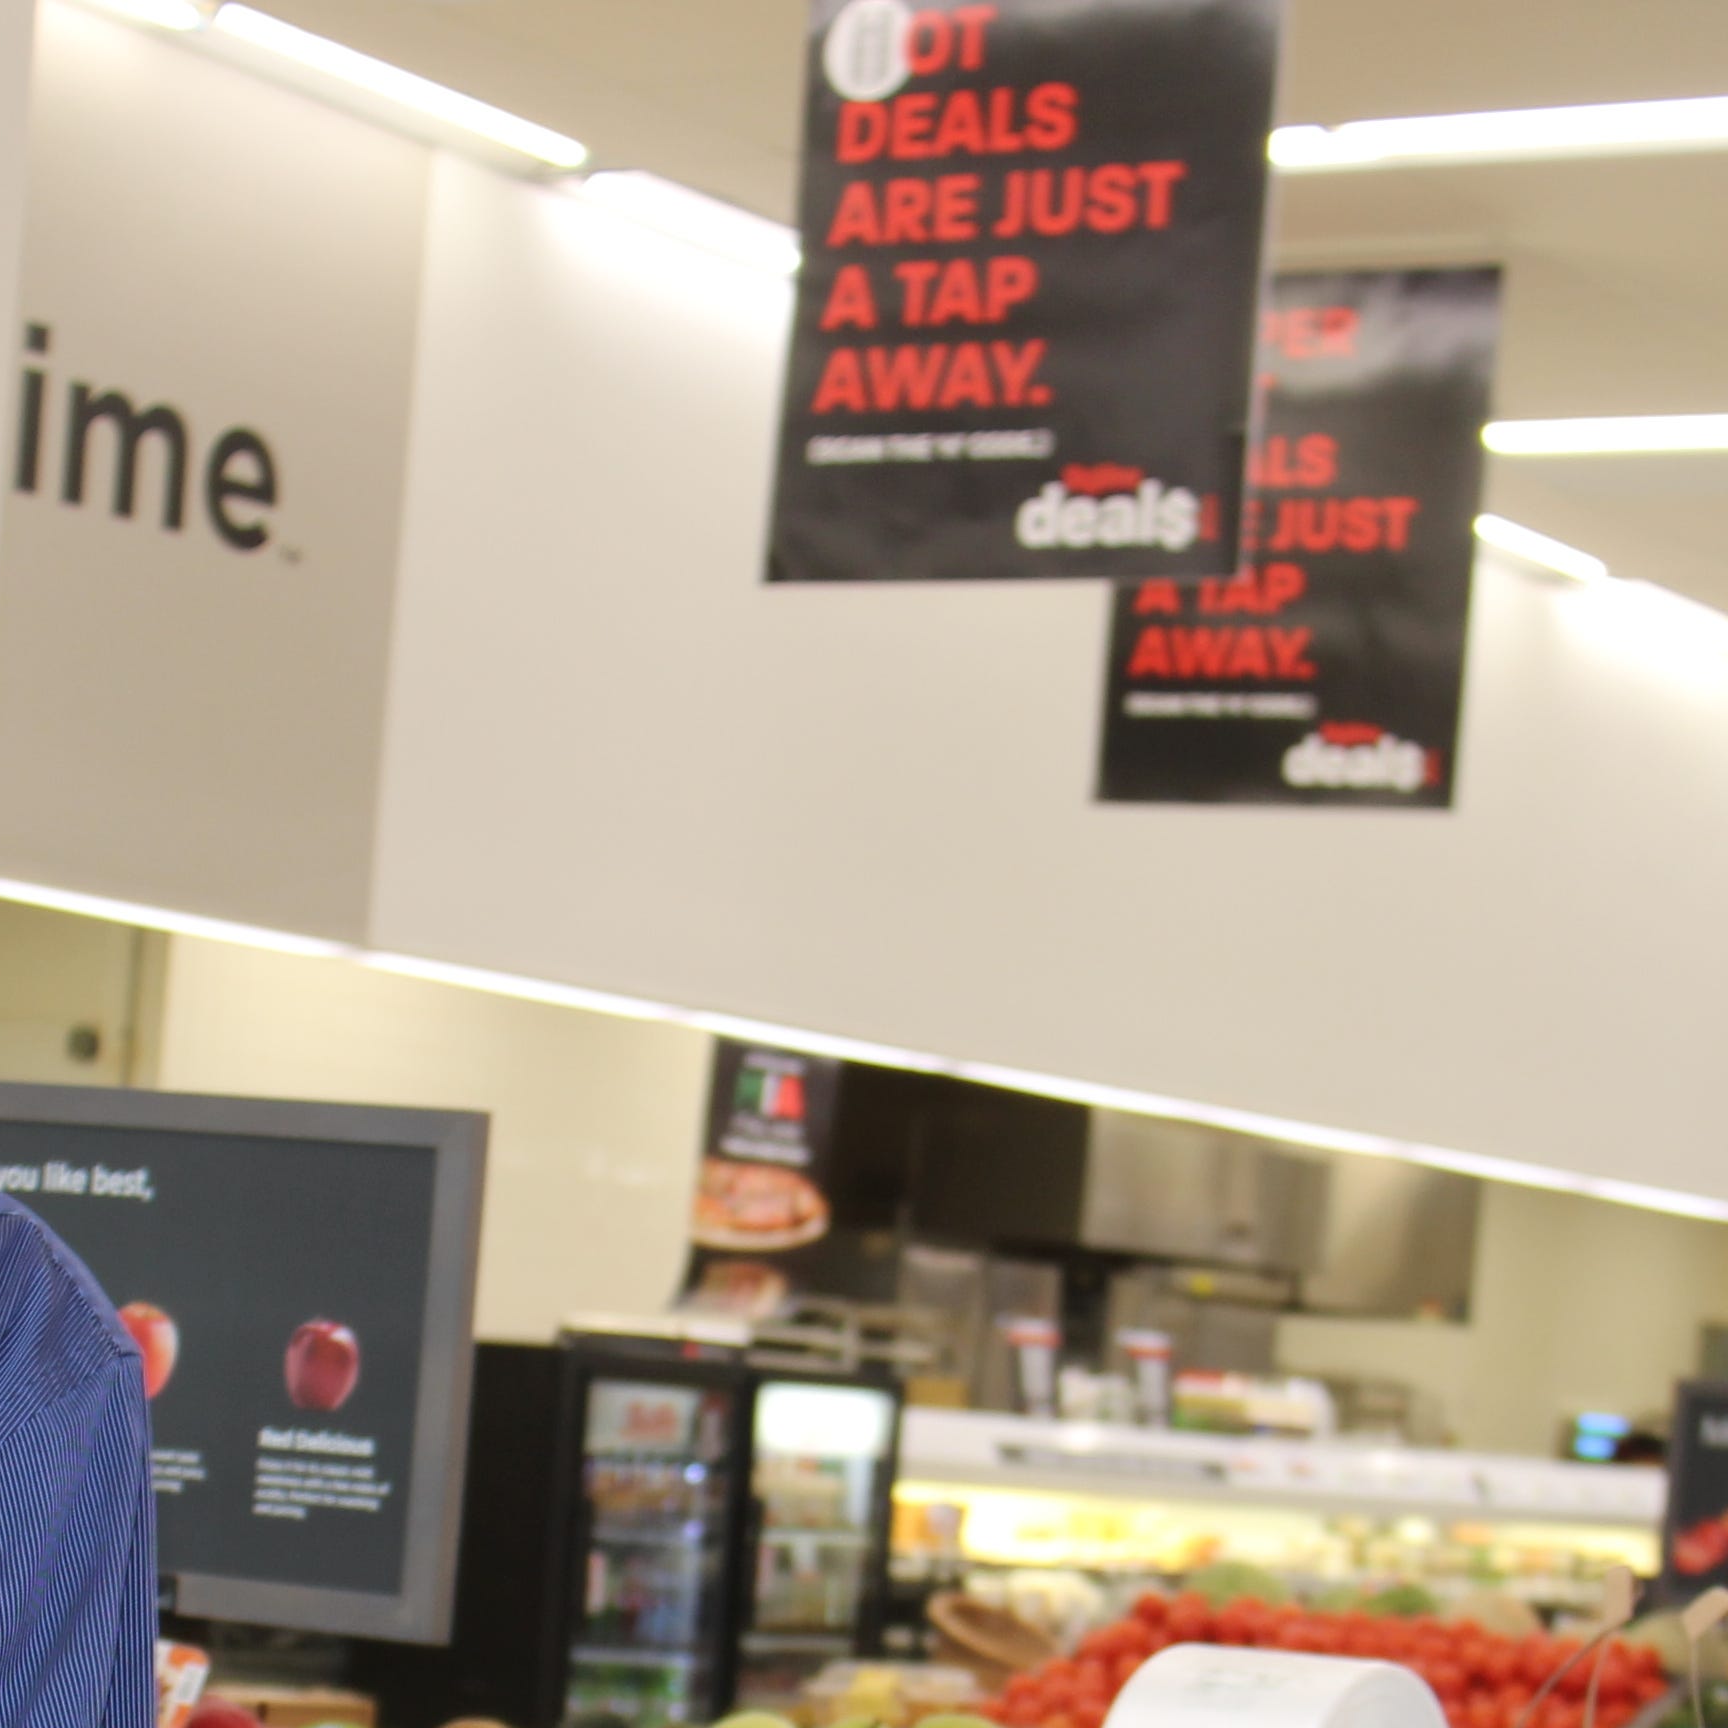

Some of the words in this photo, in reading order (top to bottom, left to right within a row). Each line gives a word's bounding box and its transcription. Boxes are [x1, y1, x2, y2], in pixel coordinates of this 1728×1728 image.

[836, 82, 1080, 164] DEALS
[827, 175, 982, 247] ARE
[992, 161, 1186, 238] JUST
[820, 266, 876, 331] A
[896, 256, 1040, 325] TAP
[811, 338, 1054, 413] AWAY.
[1274, 497, 1420, 552] JUST
[1127, 626, 1318, 680] AWAY.
[42, 1160, 88, 1194] like
[91, 1163, 154, 1201] best,
